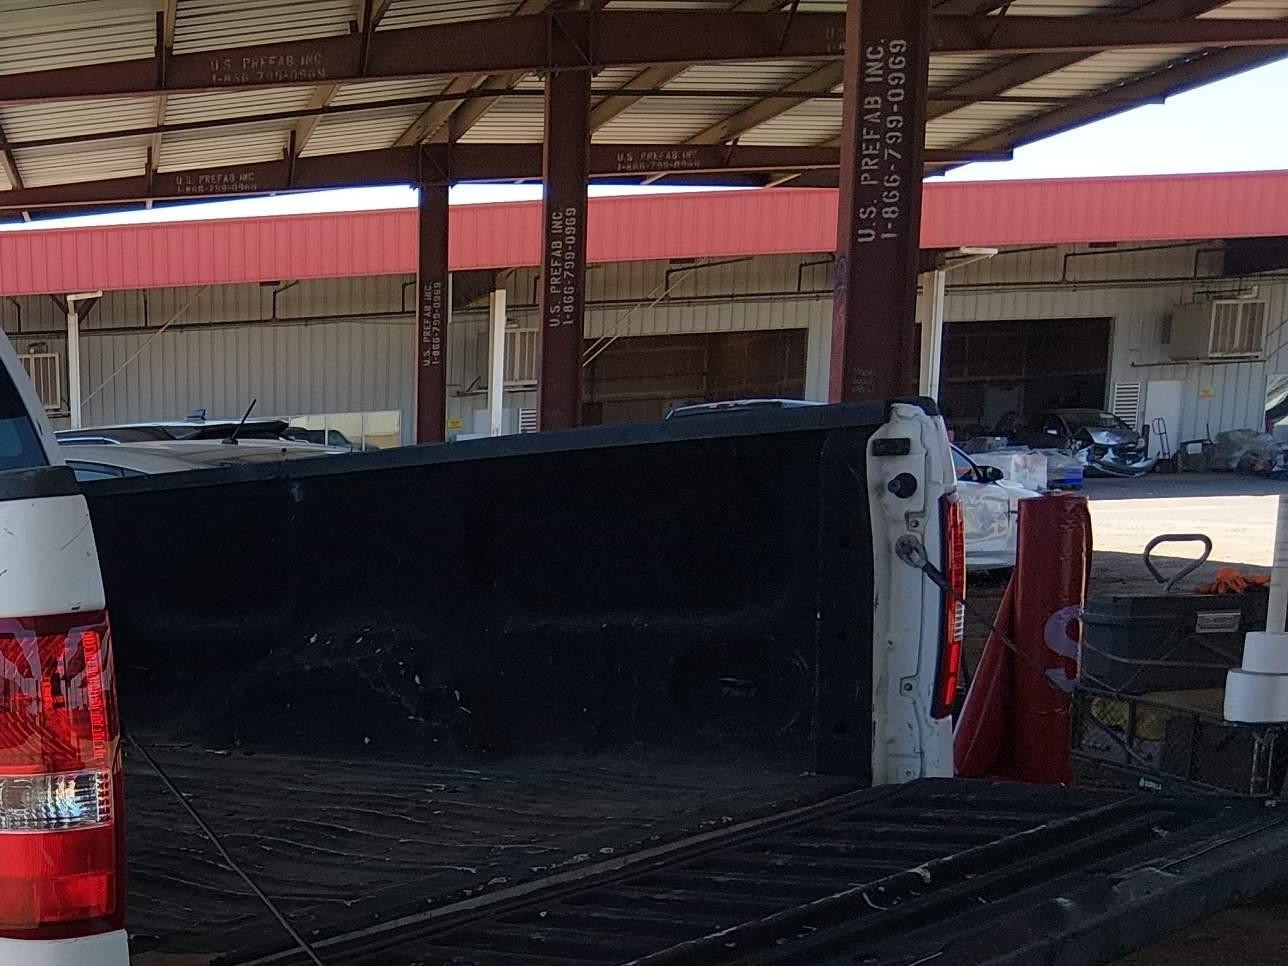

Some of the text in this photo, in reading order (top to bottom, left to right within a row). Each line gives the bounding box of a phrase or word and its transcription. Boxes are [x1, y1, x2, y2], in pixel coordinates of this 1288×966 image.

[857, 38, 885, 242] U.S. PREFAB INC.
[880, 39, 906, 239] 1-866-799-0969
[550, 240, 562, 294] PREFAB
[562, 207, 576, 325] 1-866-799-0969
[423, 305, 431, 342] PREFAB
[549, 301, 560, 327] U.S.
